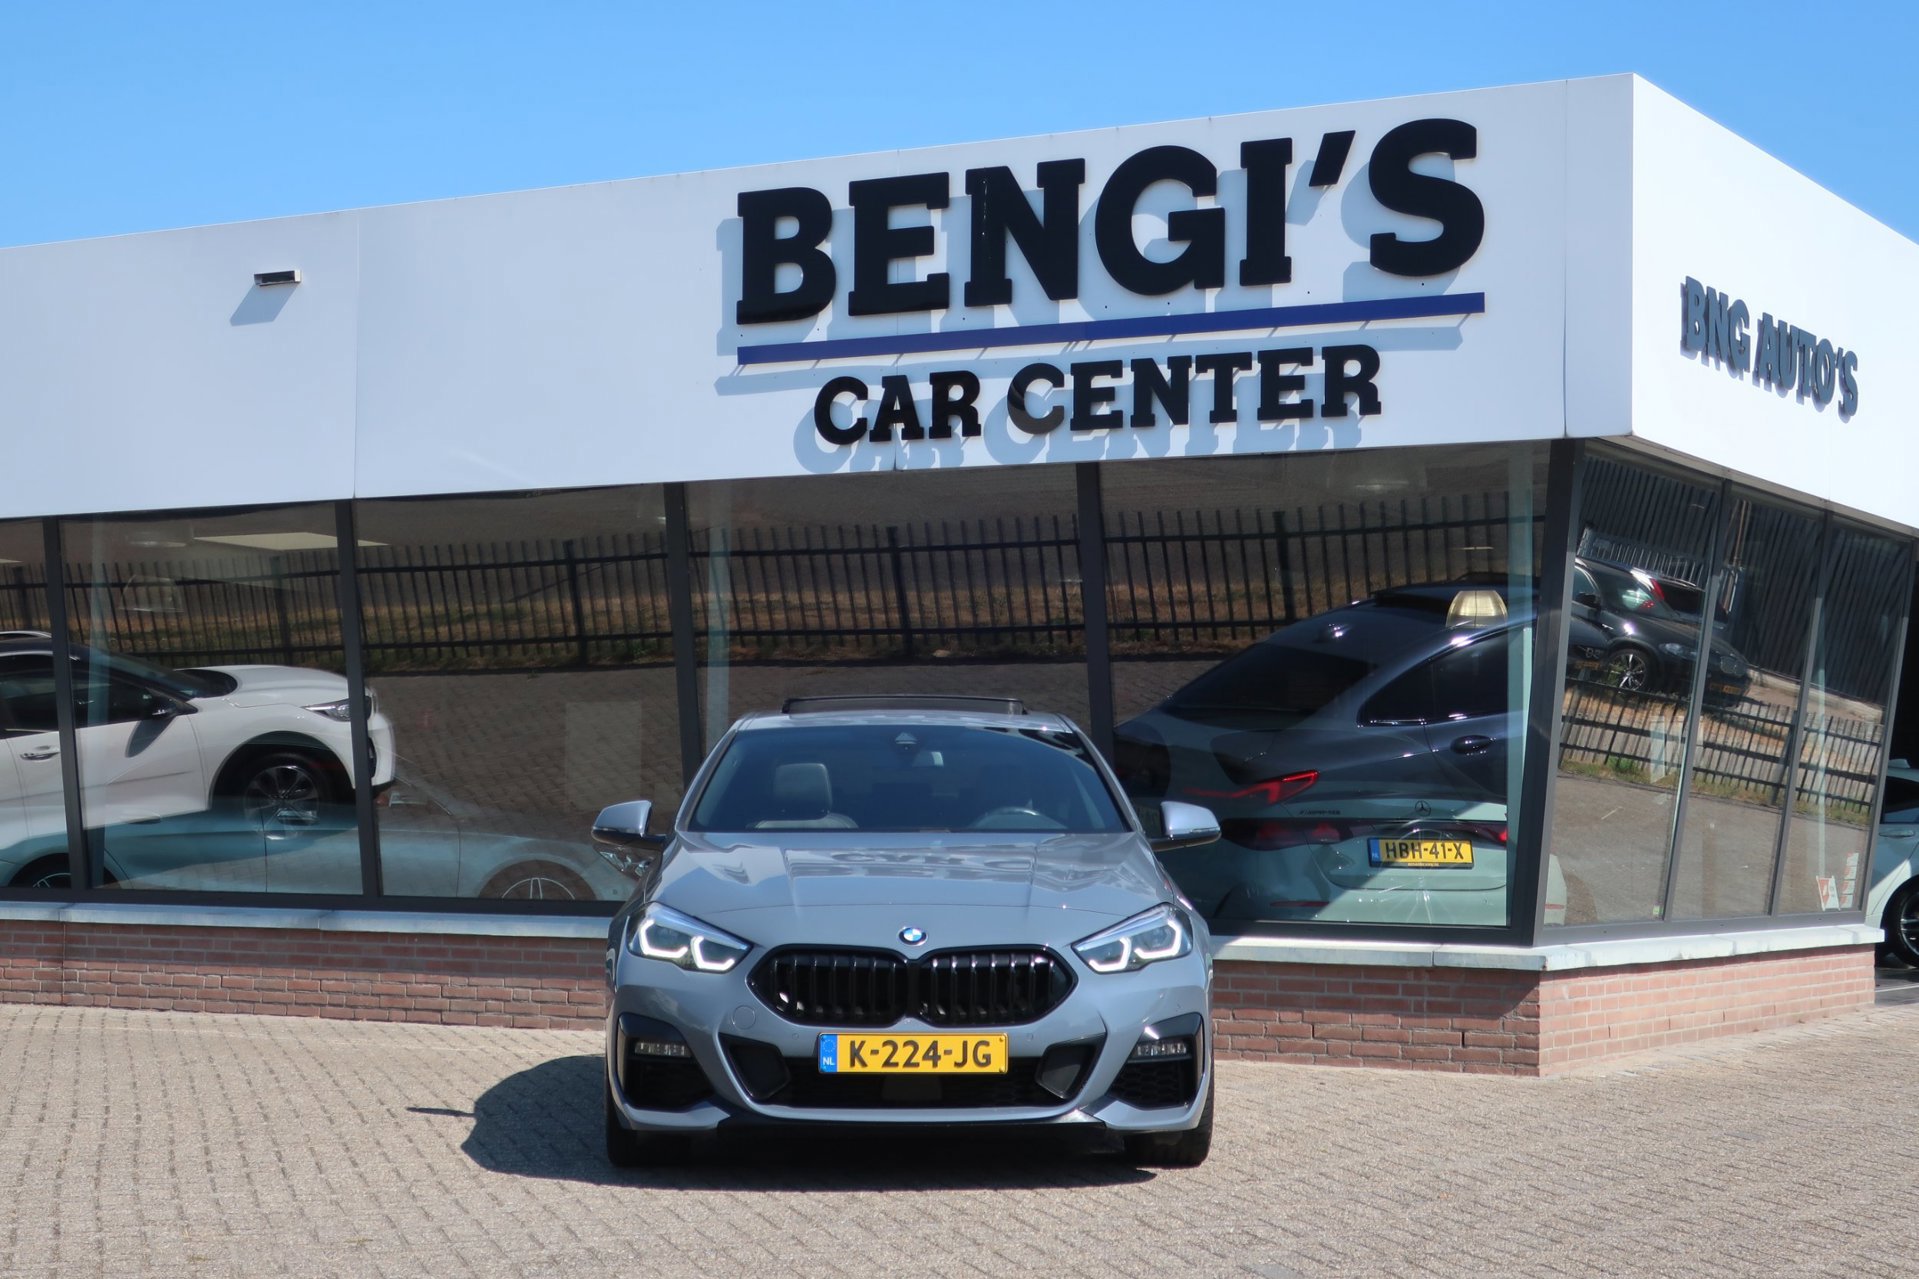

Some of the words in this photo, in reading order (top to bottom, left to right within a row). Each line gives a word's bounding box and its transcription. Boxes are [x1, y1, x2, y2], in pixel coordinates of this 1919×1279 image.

[736, 117, 1485, 325] BENGI'S
[1684, 275, 1751, 374] BNG
[1757, 311, 1859, 417] AUTO'S
[813, 369, 982, 445] CAR
[1007, 343, 1382, 435] CENTER
[1385, 842, 1464, 860] HBH-41-X
[822, 1056, 836, 1066] NL
[849, 1040, 992, 1068] K-224-JG
